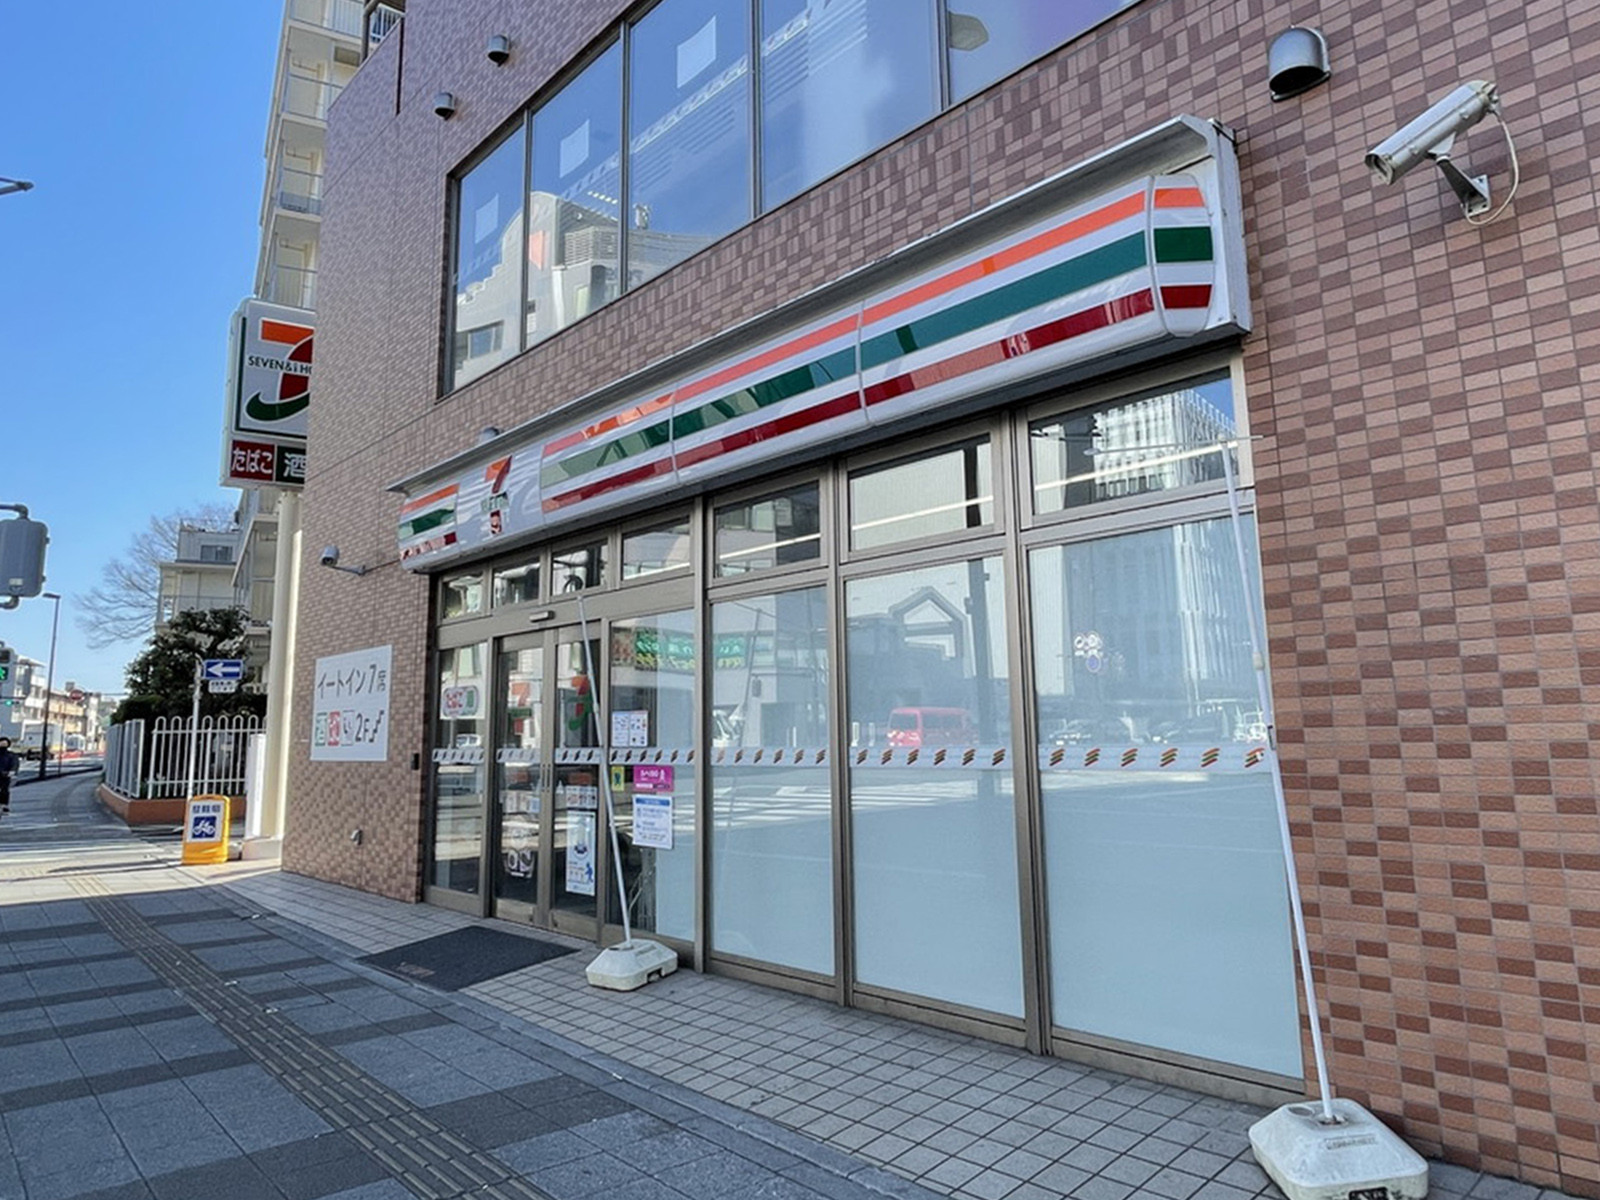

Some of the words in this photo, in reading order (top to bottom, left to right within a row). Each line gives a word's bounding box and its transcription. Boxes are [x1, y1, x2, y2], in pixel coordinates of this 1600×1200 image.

[231, 447, 273, 474] たばこ
[282, 451, 308, 478] 酒
